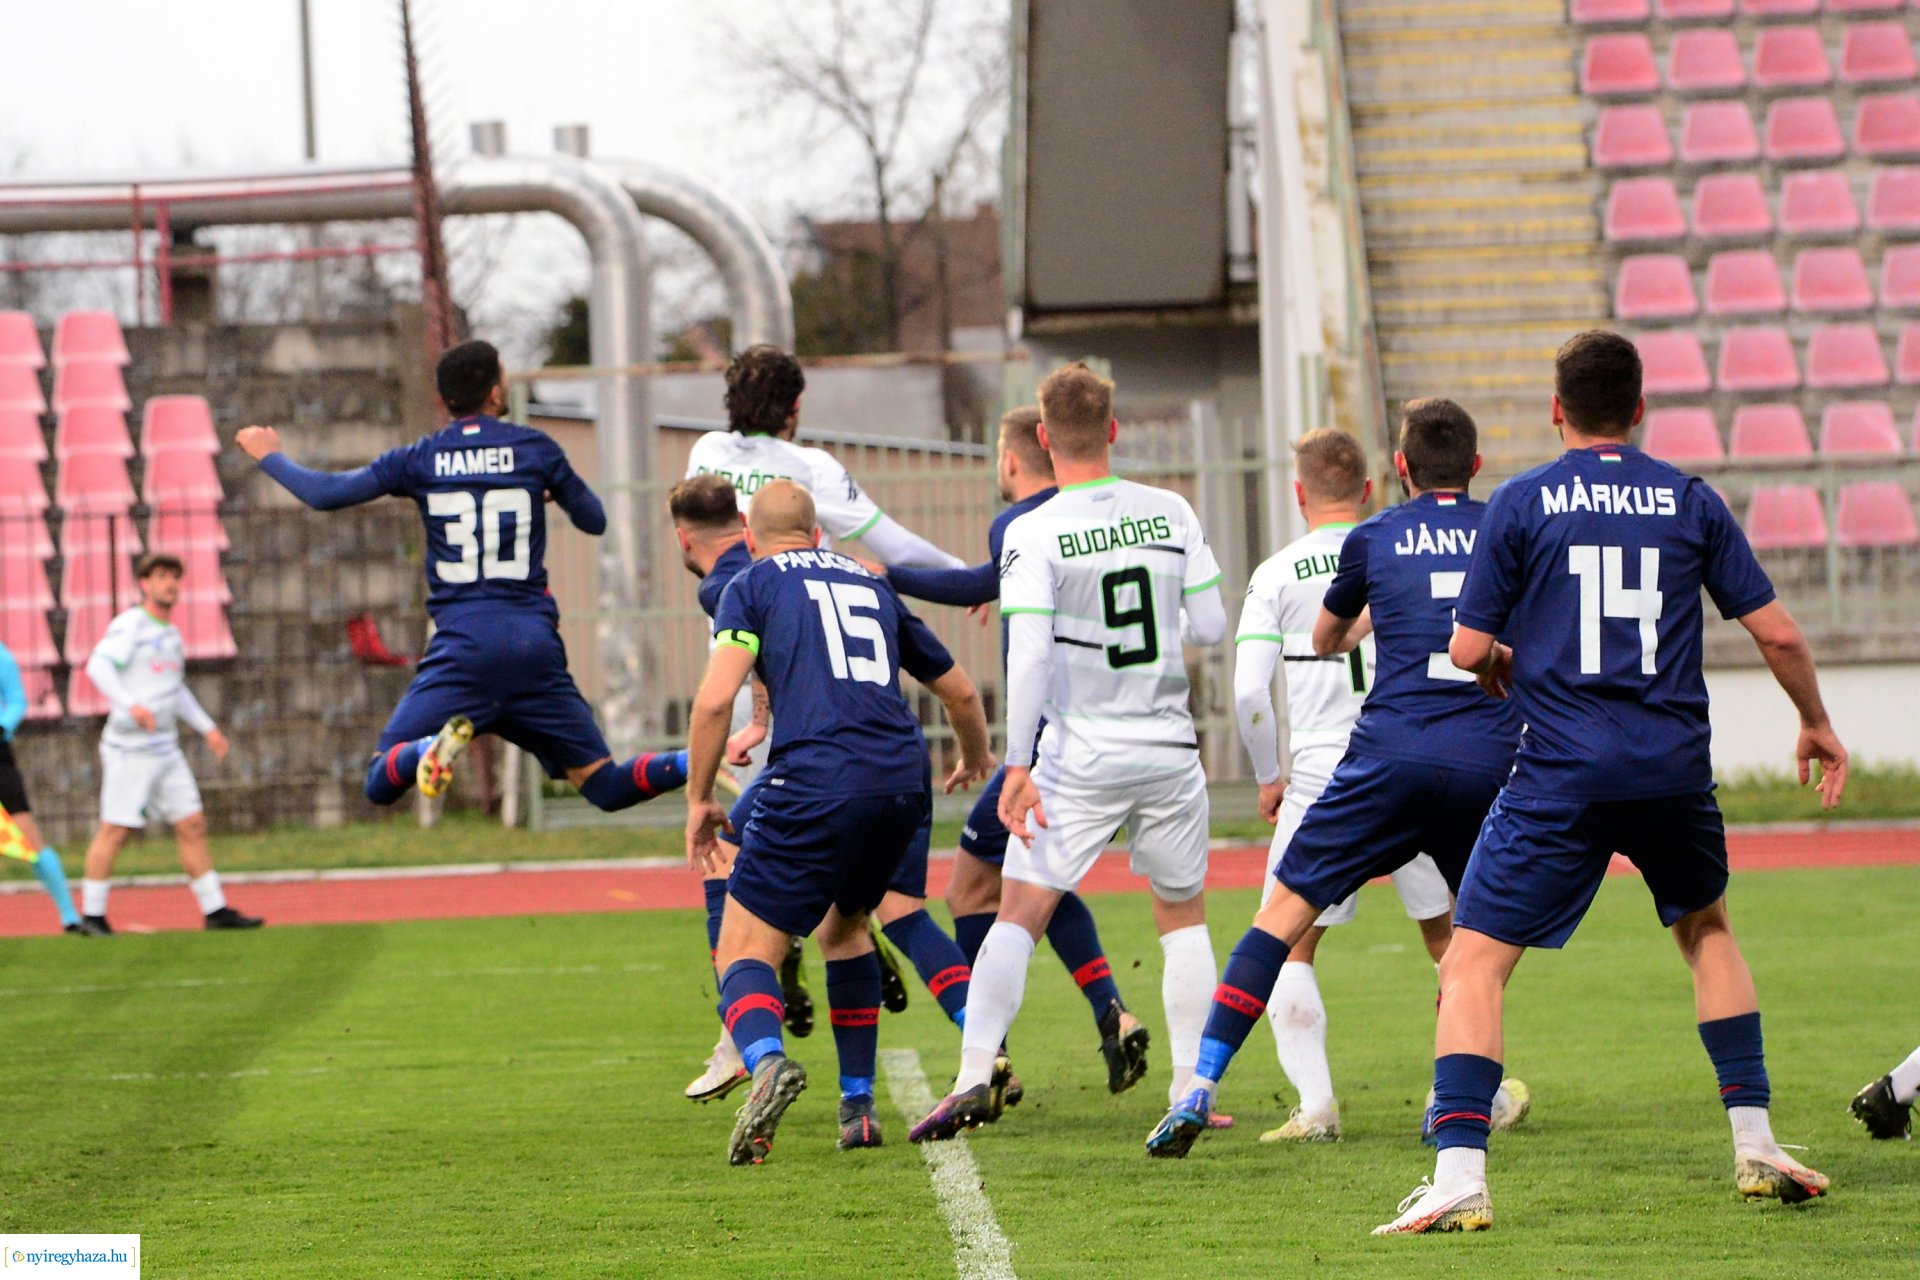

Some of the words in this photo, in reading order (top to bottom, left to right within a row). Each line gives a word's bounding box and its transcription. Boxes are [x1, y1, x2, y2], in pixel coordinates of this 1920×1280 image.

[435, 447, 514, 477] HAMED
[427, 488, 532, 584] 30
[1057, 515, 1171, 559] BUDAÖRS
[803, 579, 891, 687] 15
[1101, 564, 1160, 671] 9
[1568, 545, 1663, 675] 14
